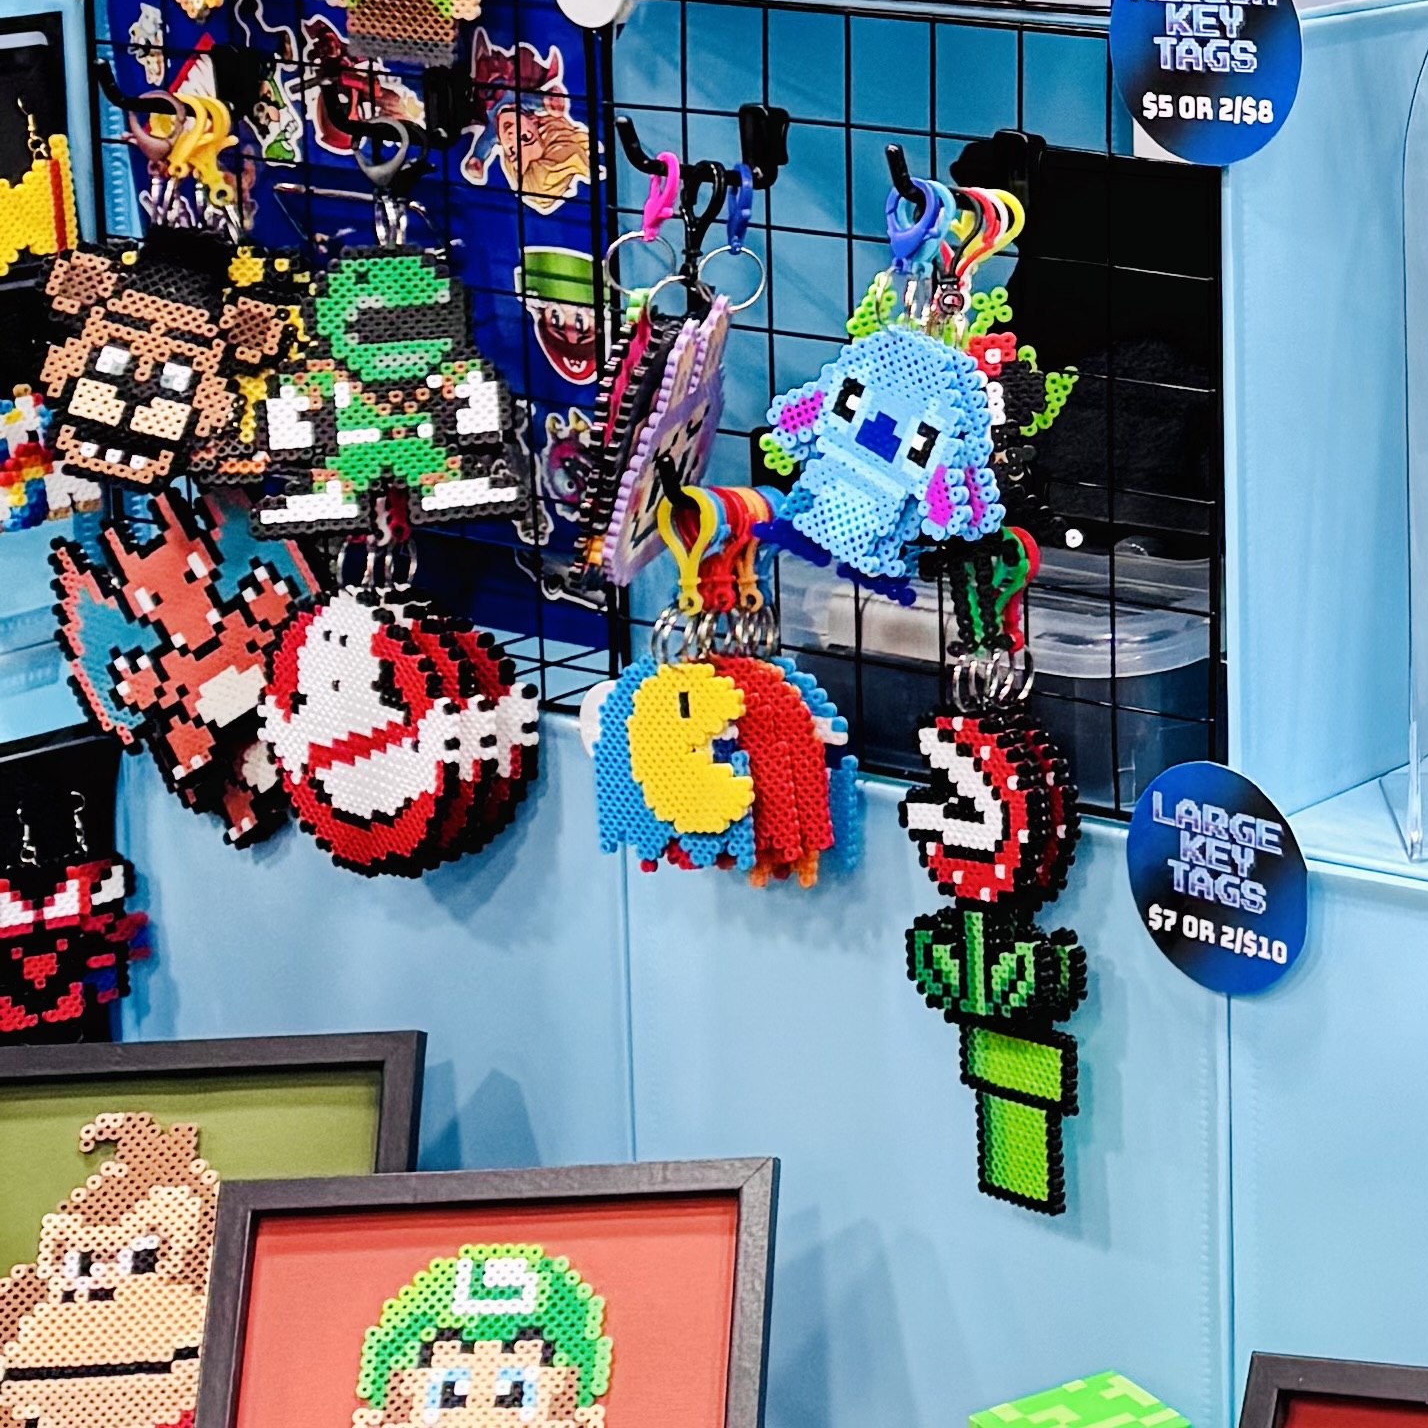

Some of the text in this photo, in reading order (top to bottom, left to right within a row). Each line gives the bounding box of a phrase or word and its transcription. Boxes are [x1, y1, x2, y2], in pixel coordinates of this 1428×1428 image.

[1165, 3, 1244, 38] KEY
[1153, 36, 1258, 73] TAGS
[1142, 91, 1273, 125] $5 OR 2/$8
[1152, 790, 1284, 856] LARGE
[1179, 829, 1255, 878] KEY
[1167, 858, 1267, 915] TAGS
[1148, 903, 1288, 965] $7 OR 2/$10
